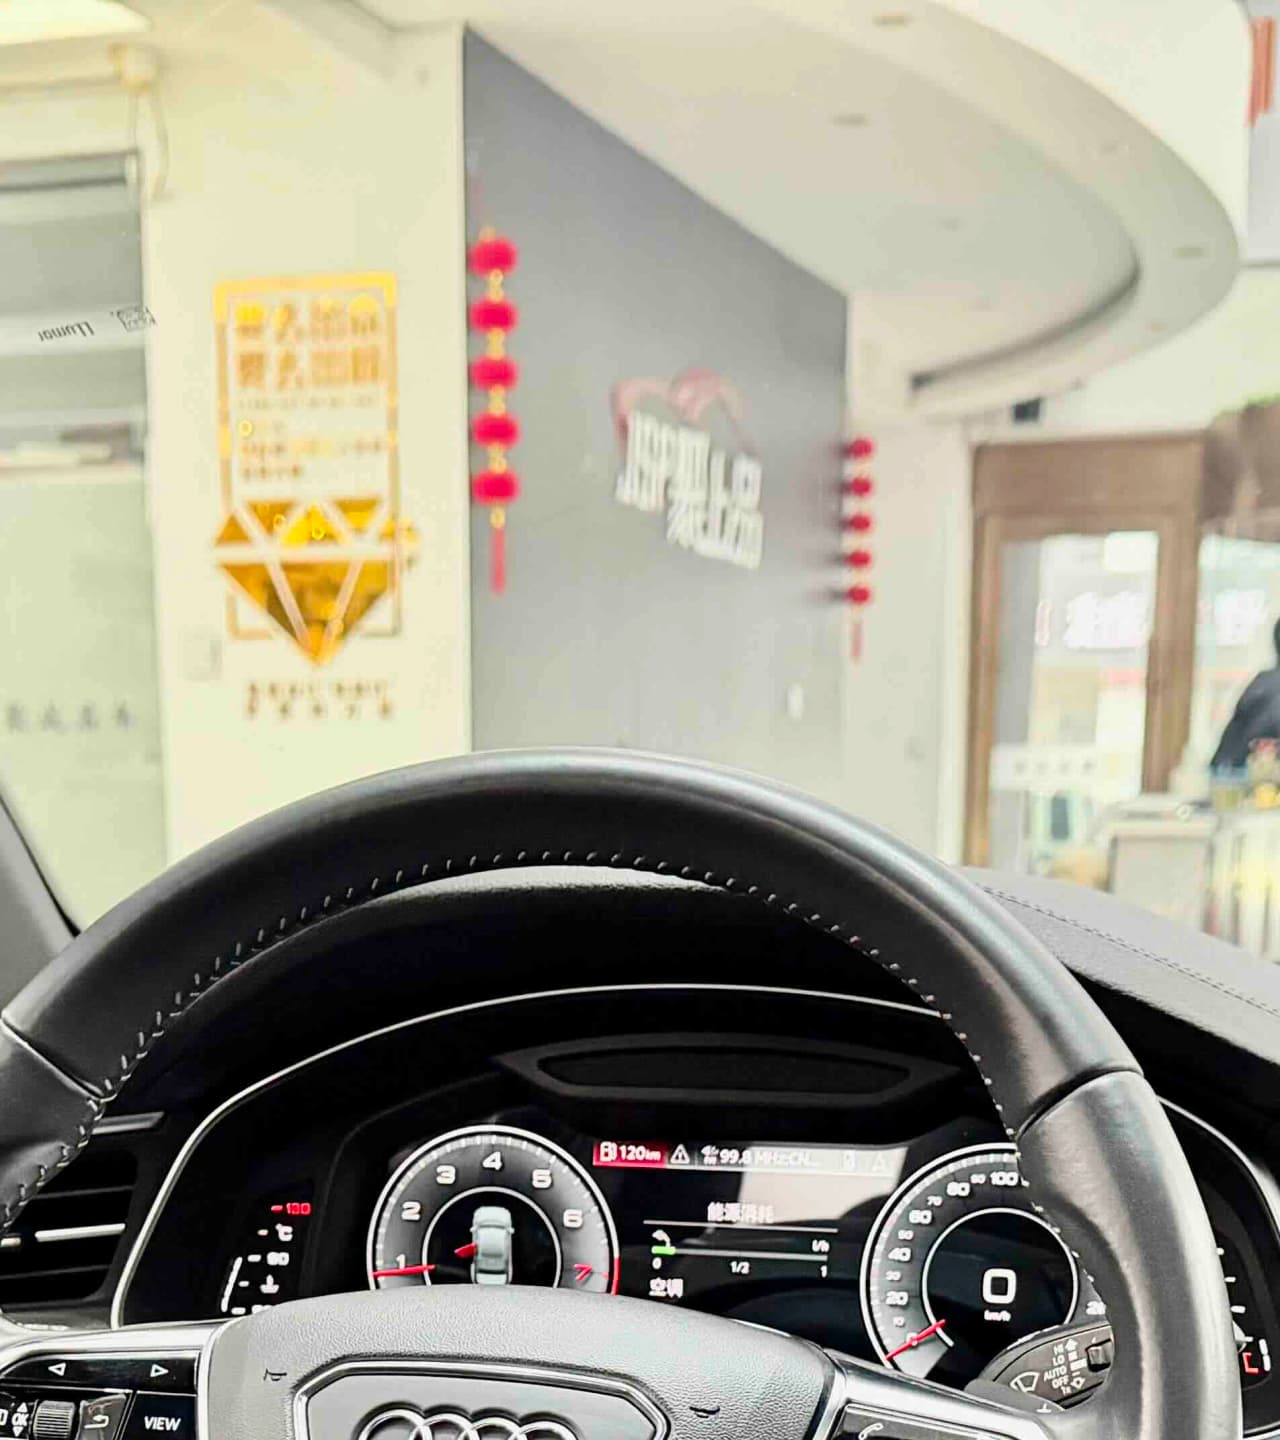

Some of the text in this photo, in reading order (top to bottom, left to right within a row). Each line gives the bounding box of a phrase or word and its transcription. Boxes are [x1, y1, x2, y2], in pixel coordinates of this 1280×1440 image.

[482, 1150, 503, 1171] 4
[719, 1149, 751, 1165] 99.8
[435, 1165, 456, 1185] 3
[532, 1168, 552, 1189] 5
[402, 1201, 421, 1220] 2
[563, 1209, 583, 1229] 6
[982, 1268, 1017, 1304] 0
[1052, 1354, 1065, 1367] LO
[1043, 1365, 1067, 1382] AUTO
[1051, 1375, 1069, 1389] OFF
[11, 1413, 28, 1427] OK
[144, 1416, 181, 1432] VIEW
